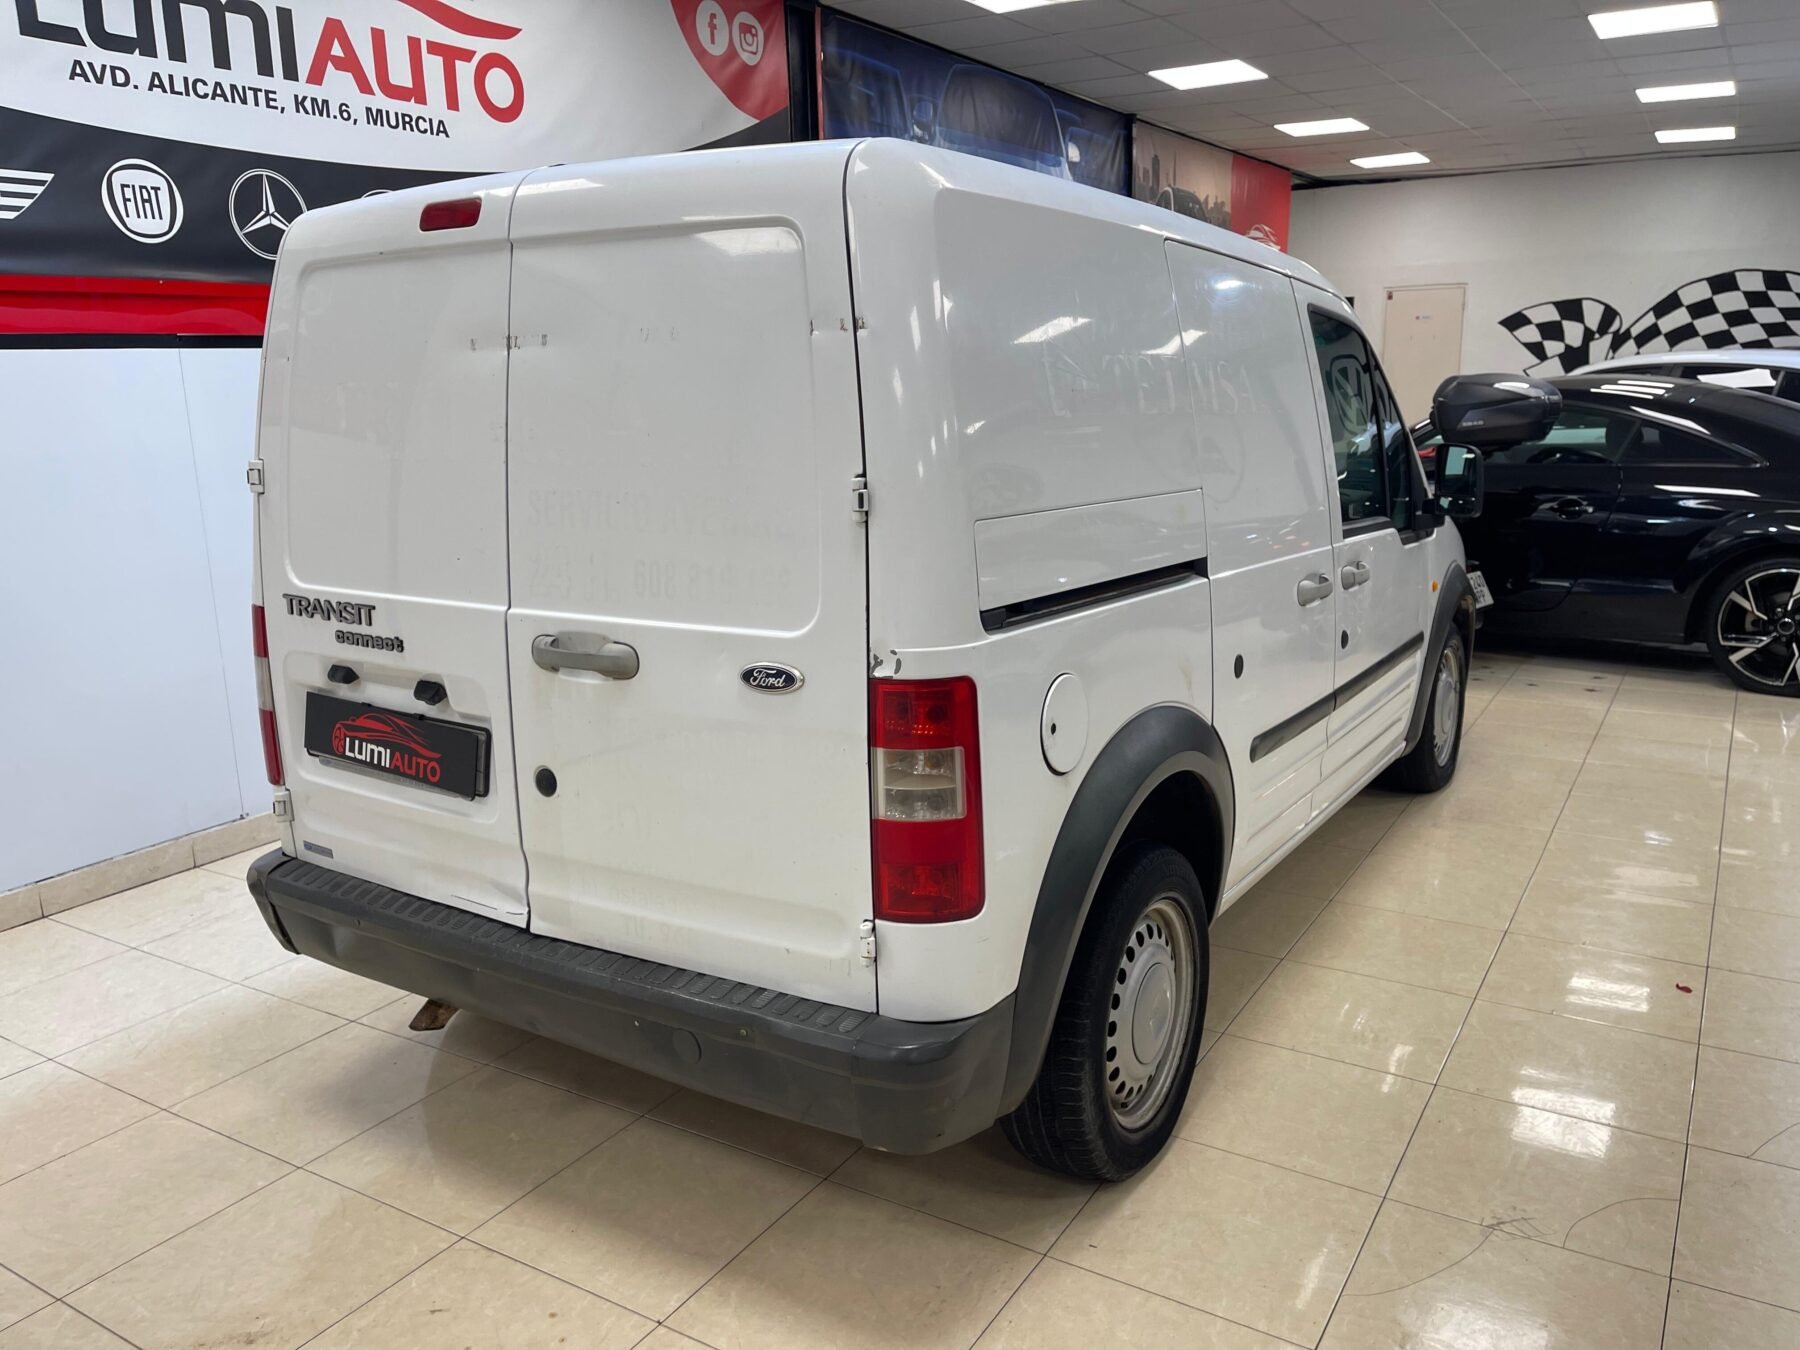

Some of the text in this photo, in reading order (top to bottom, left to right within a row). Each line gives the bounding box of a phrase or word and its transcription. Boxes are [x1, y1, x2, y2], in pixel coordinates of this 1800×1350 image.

[68, 58, 450, 138] AVD. ALICANTE, KM.6, MURCIA
[120, 183, 163, 220] FIAT
[282, 593, 376, 627] TRANSIT
[334, 629, 404, 653] connect
[749, 668, 787, 688] Ford
